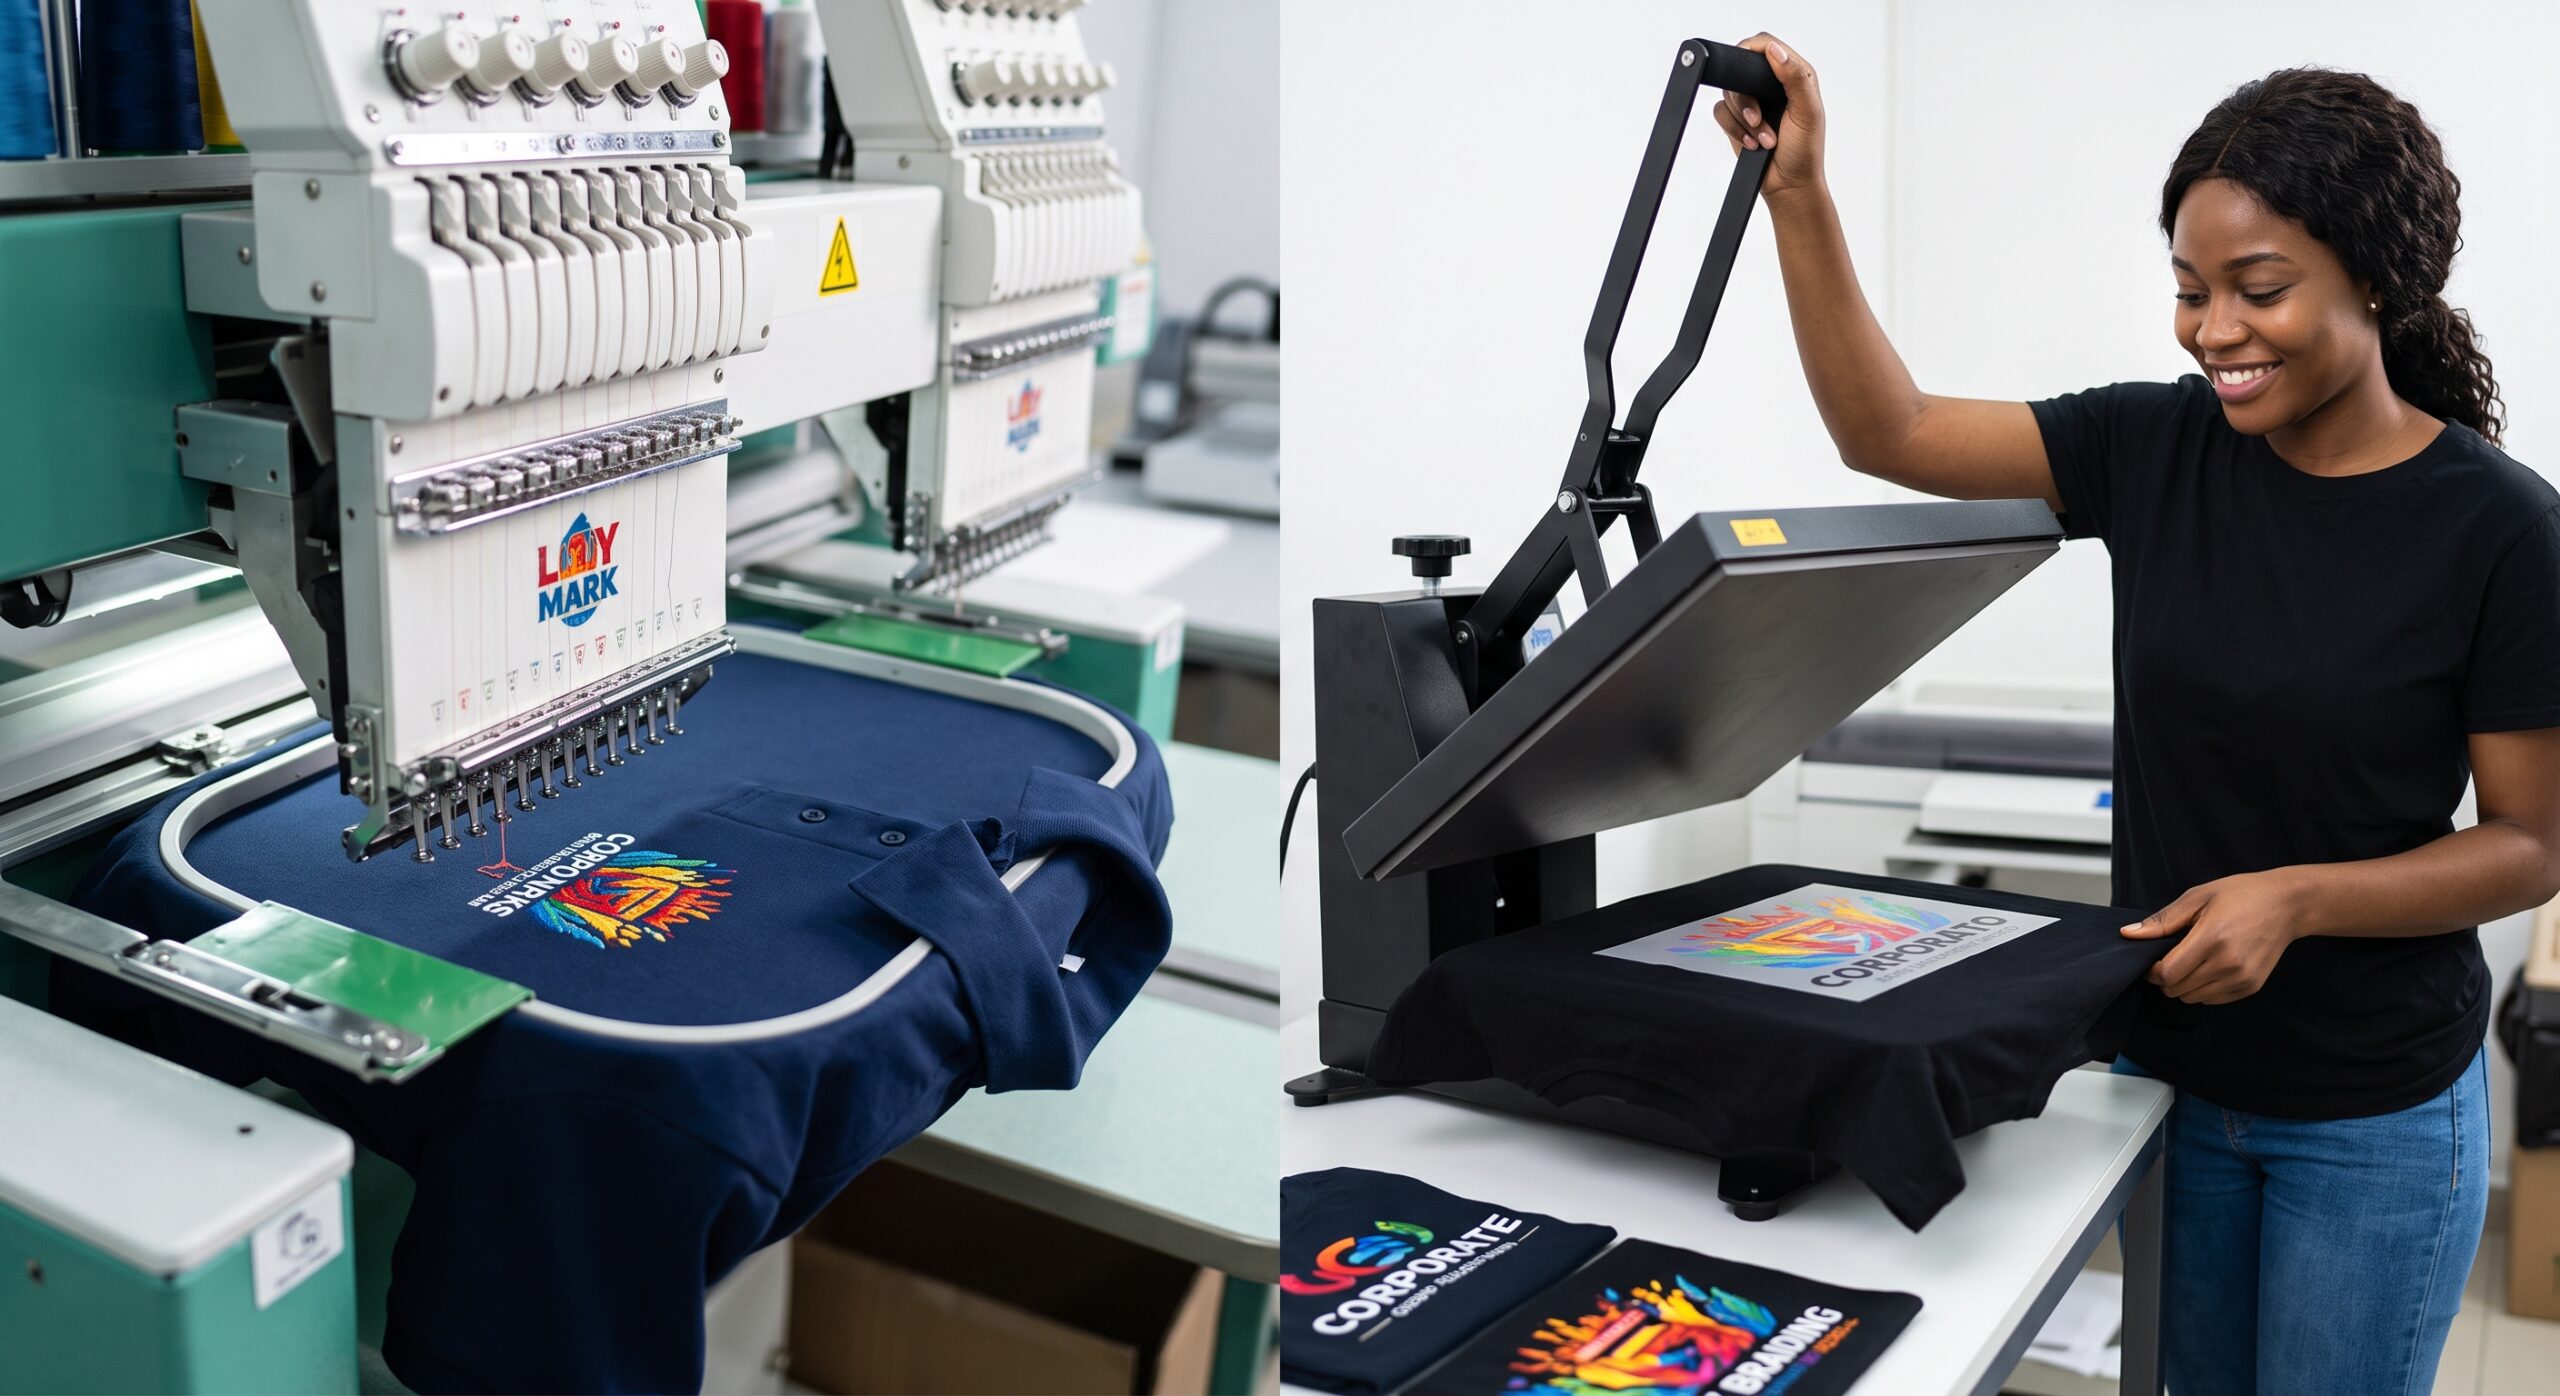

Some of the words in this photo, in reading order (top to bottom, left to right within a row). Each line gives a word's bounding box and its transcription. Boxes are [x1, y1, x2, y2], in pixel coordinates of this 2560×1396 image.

[538, 565, 618, 623] MARK
[1811, 916, 2008, 987] CORPORATO
[1312, 1213, 1522, 1335] CORPORATE
[1718, 1305, 1844, 1395] BRAIDING
